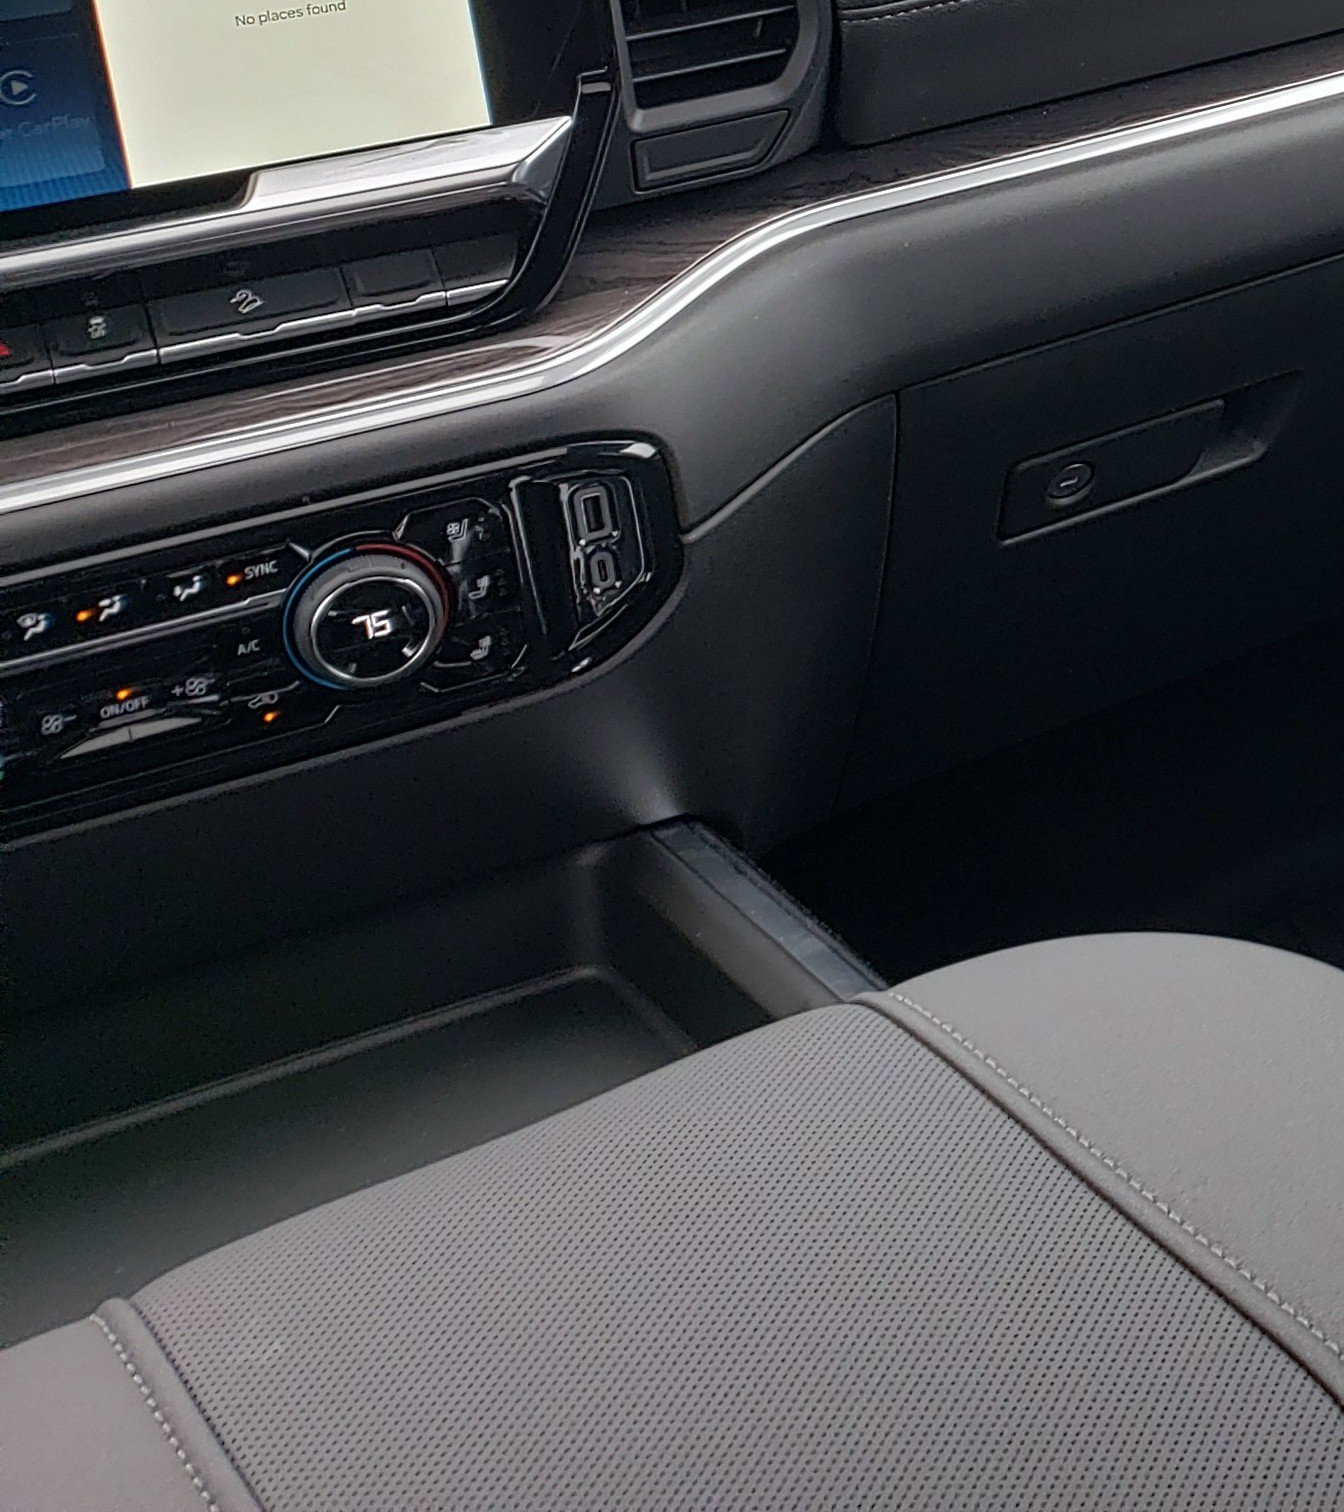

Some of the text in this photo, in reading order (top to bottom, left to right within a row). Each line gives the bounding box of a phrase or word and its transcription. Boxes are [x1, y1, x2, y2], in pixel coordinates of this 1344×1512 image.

[235, 14, 256, 26] No
[258, 9, 304, 26] places
[243, 559, 279, 580] SYNC
[351, 609, 392, 640] 75
[237, 639, 261, 656] A/C
[100, 696, 150, 719] ON/OFF
